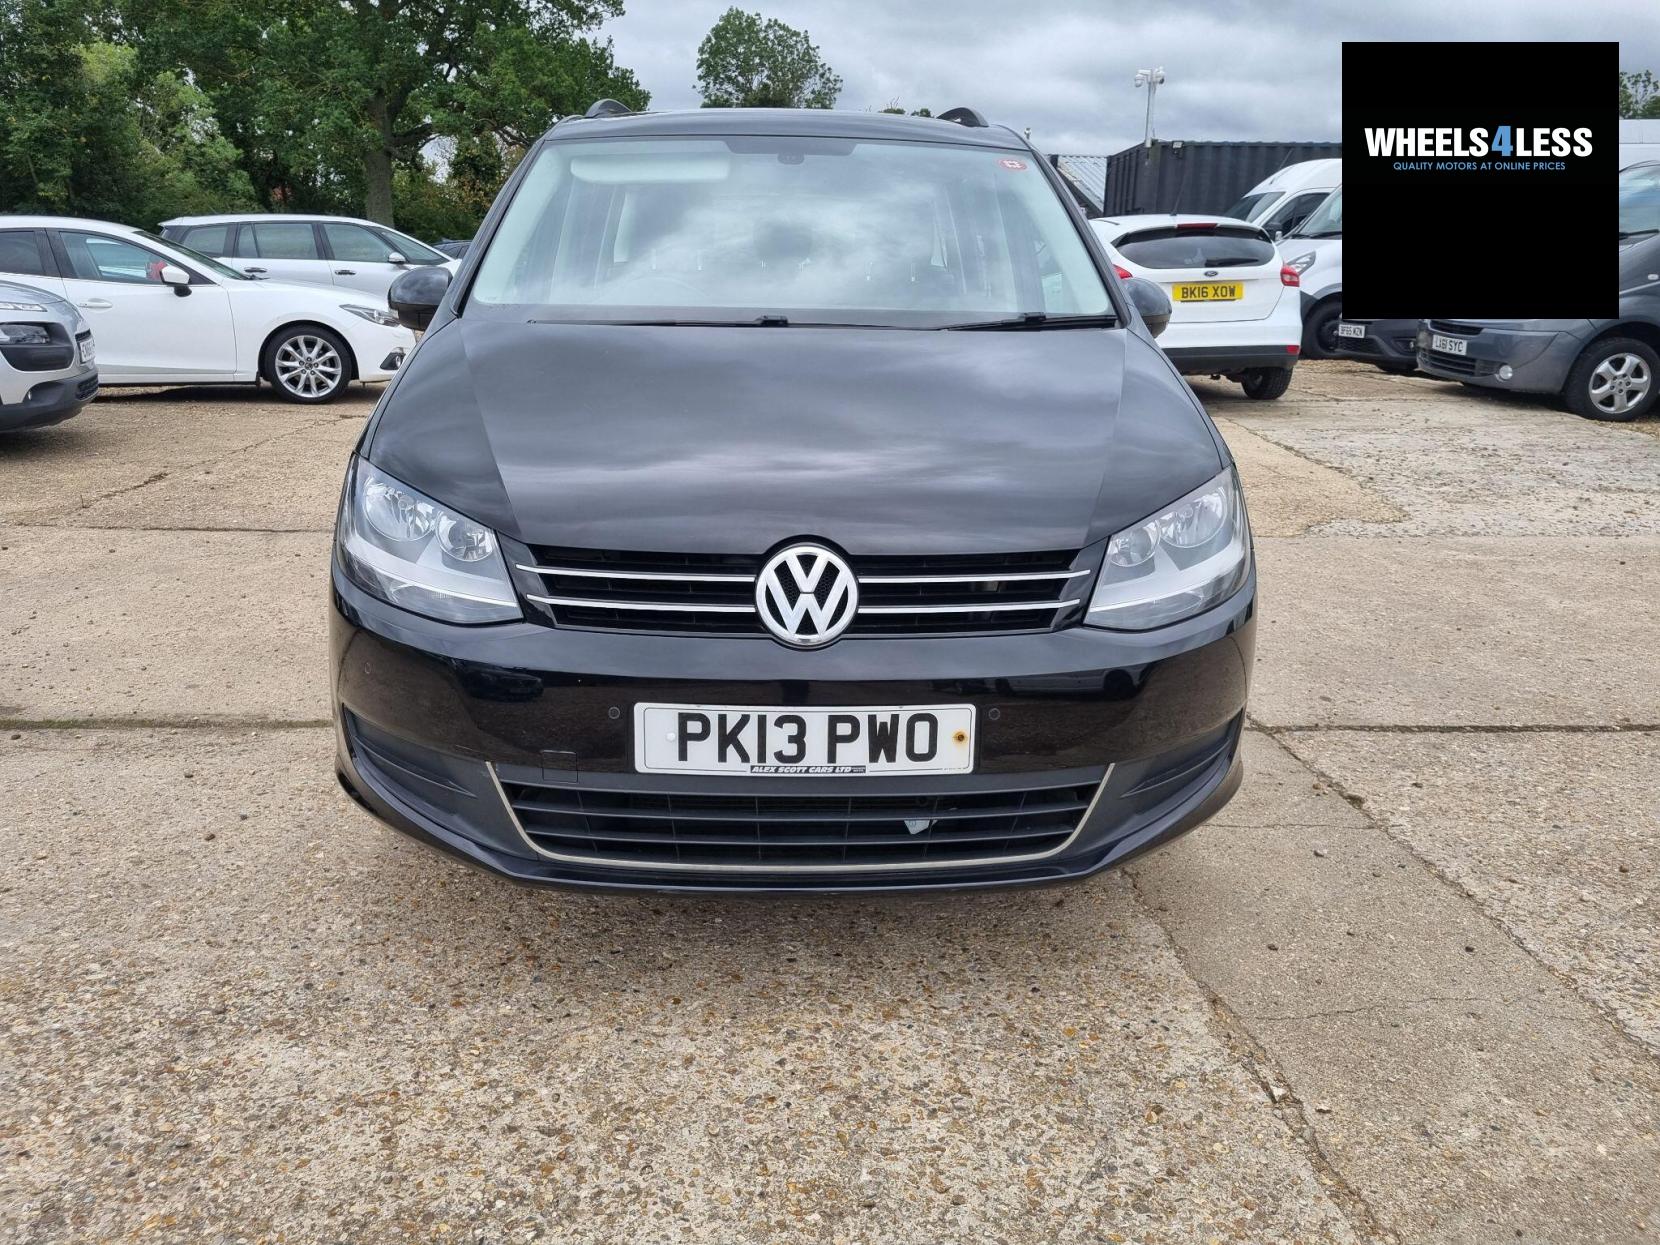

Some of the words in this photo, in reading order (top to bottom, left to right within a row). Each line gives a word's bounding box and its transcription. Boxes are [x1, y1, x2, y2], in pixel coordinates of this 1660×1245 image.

[1181, 286, 1209, 299] BK16
[1212, 285, 1236, 298] XOW
[678, 712, 807, 764] PK13
[827, 712, 939, 764] PWO
